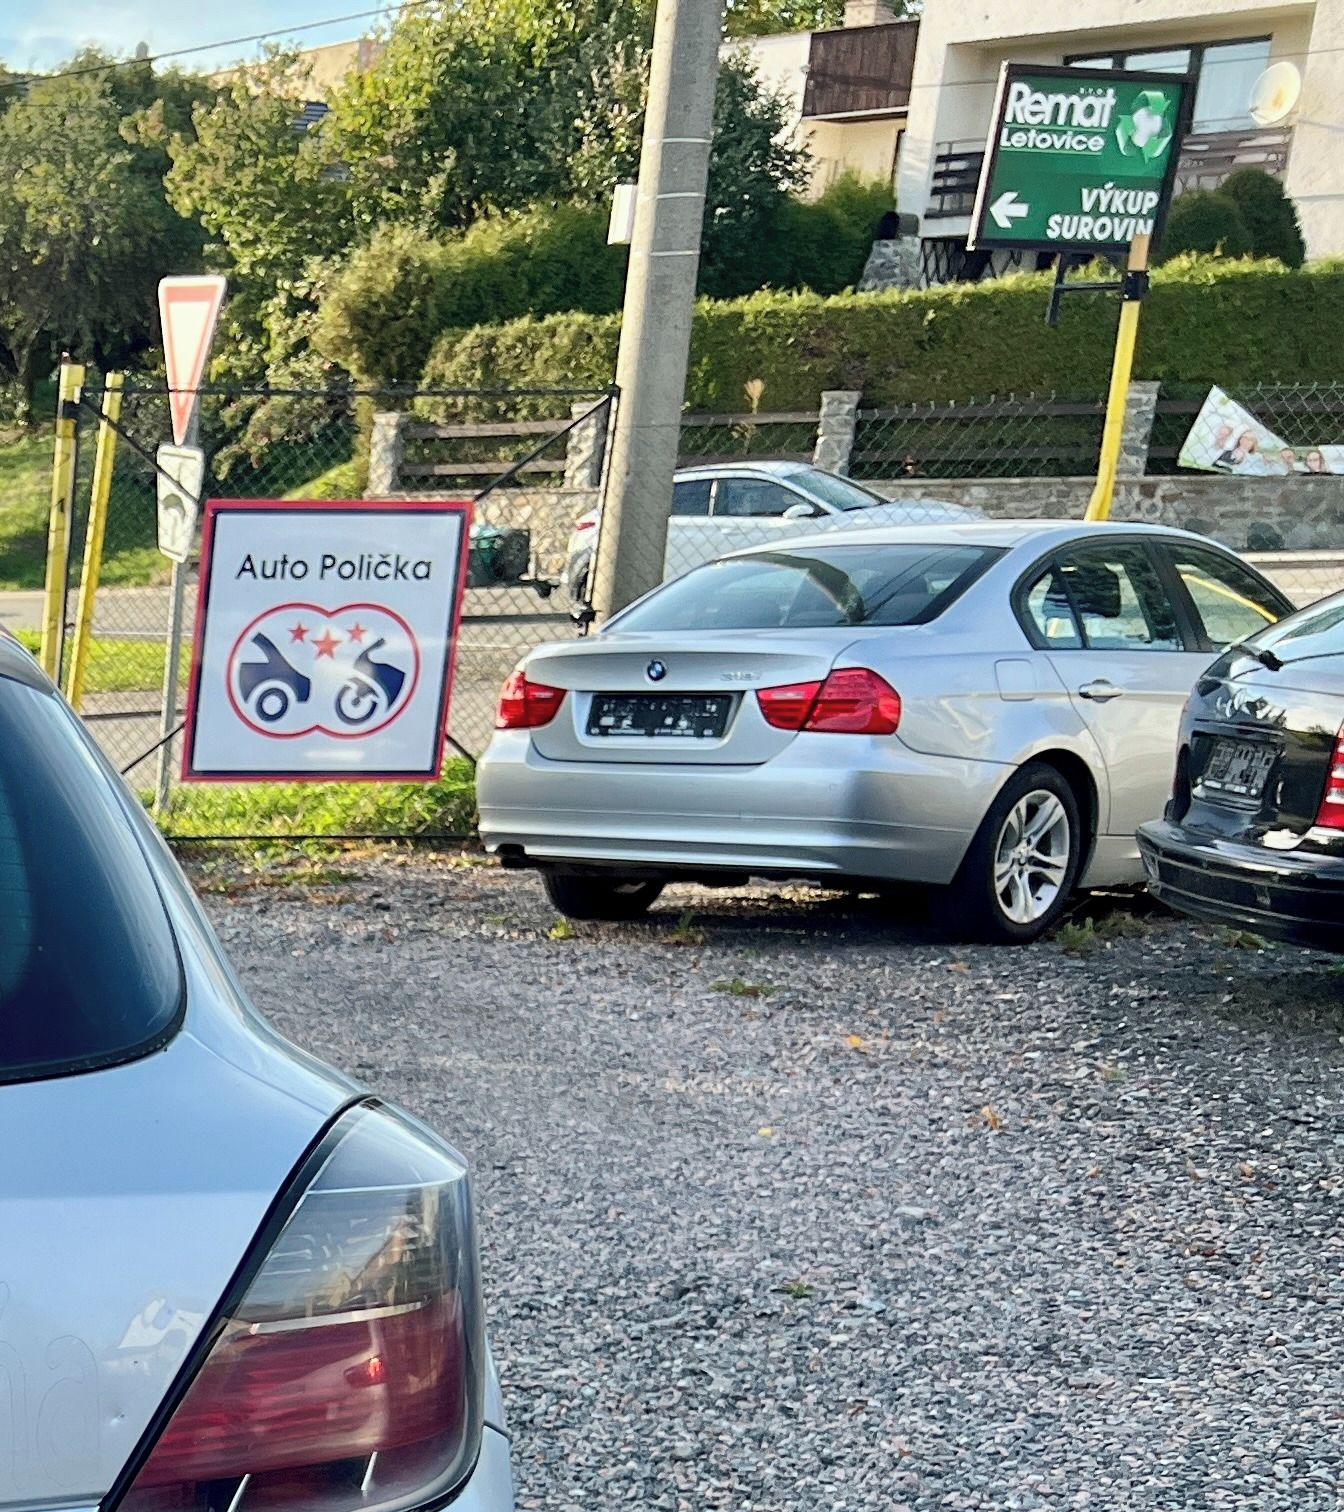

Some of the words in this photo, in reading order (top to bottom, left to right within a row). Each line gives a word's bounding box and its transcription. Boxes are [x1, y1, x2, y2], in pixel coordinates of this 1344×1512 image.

[1005, 82, 1116, 127] Remat
[1000, 128, 1105, 152] Letovice
[1081, 181, 1160, 215] VÝKUP
[1045, 214, 1154, 242] SUROVIN
[235, 553, 309, 581] Auto
[319, 551, 432, 581] Polička
